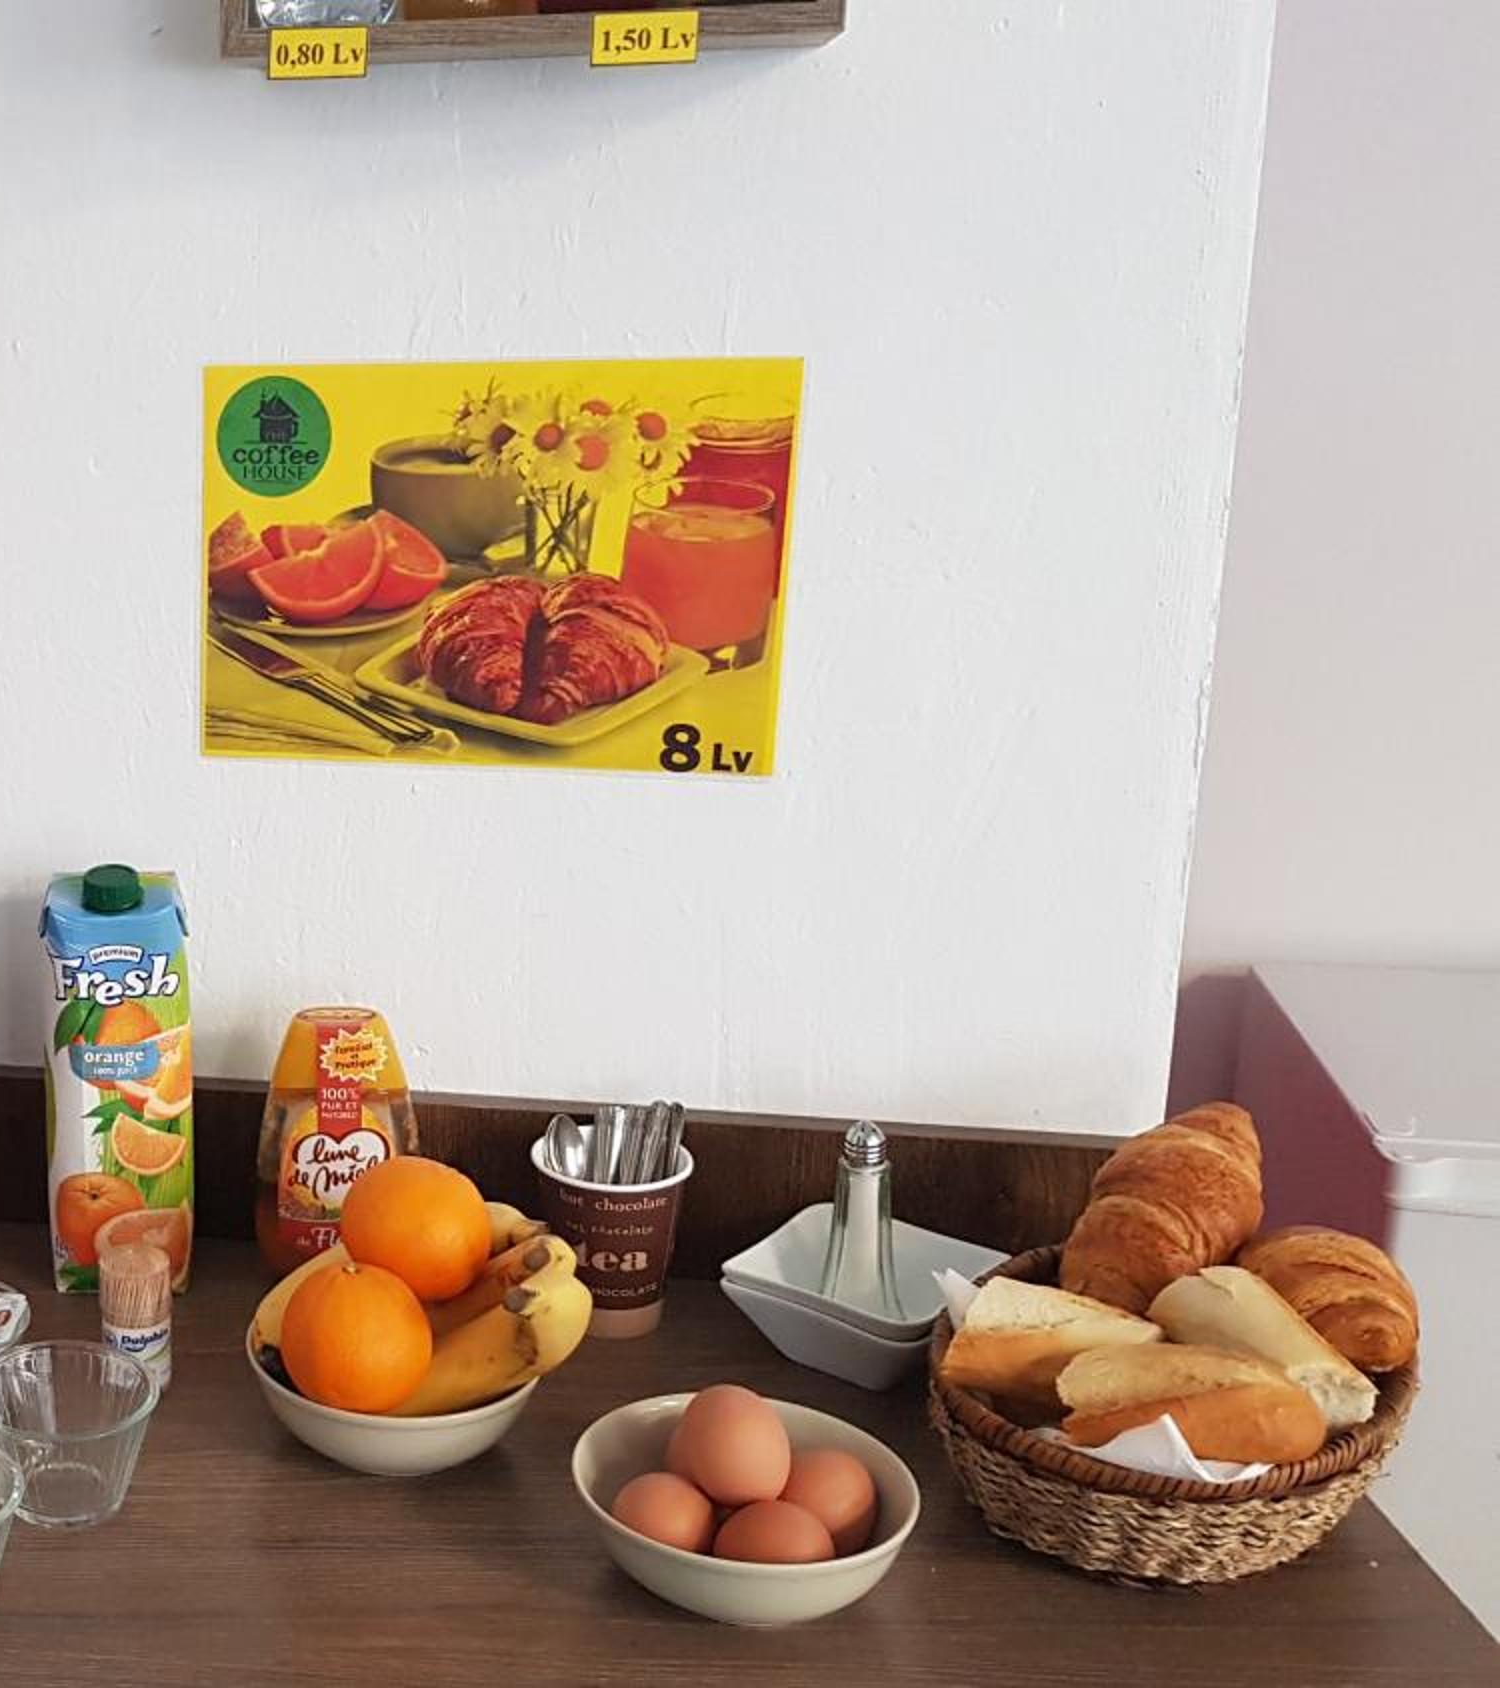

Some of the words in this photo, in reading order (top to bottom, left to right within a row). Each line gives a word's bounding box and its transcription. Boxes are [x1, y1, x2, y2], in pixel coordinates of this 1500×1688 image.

[602, 27, 651, 54] 1,50
[661, 28, 695, 49] Lv
[276, 43, 324, 68] 0,80
[333, 43, 364, 64] Lv
[232, 445, 319, 465] coffee
[243, 465, 308, 481] HOUSE
[660, 723, 700, 773] 8
[712, 743, 753, 773] Lv
[53, 956, 180, 1006] Fresh
[83, 1050, 146, 1067] orange
[595, 1197, 668, 1212] chocolate
[576, 1240, 648, 1271] tea
